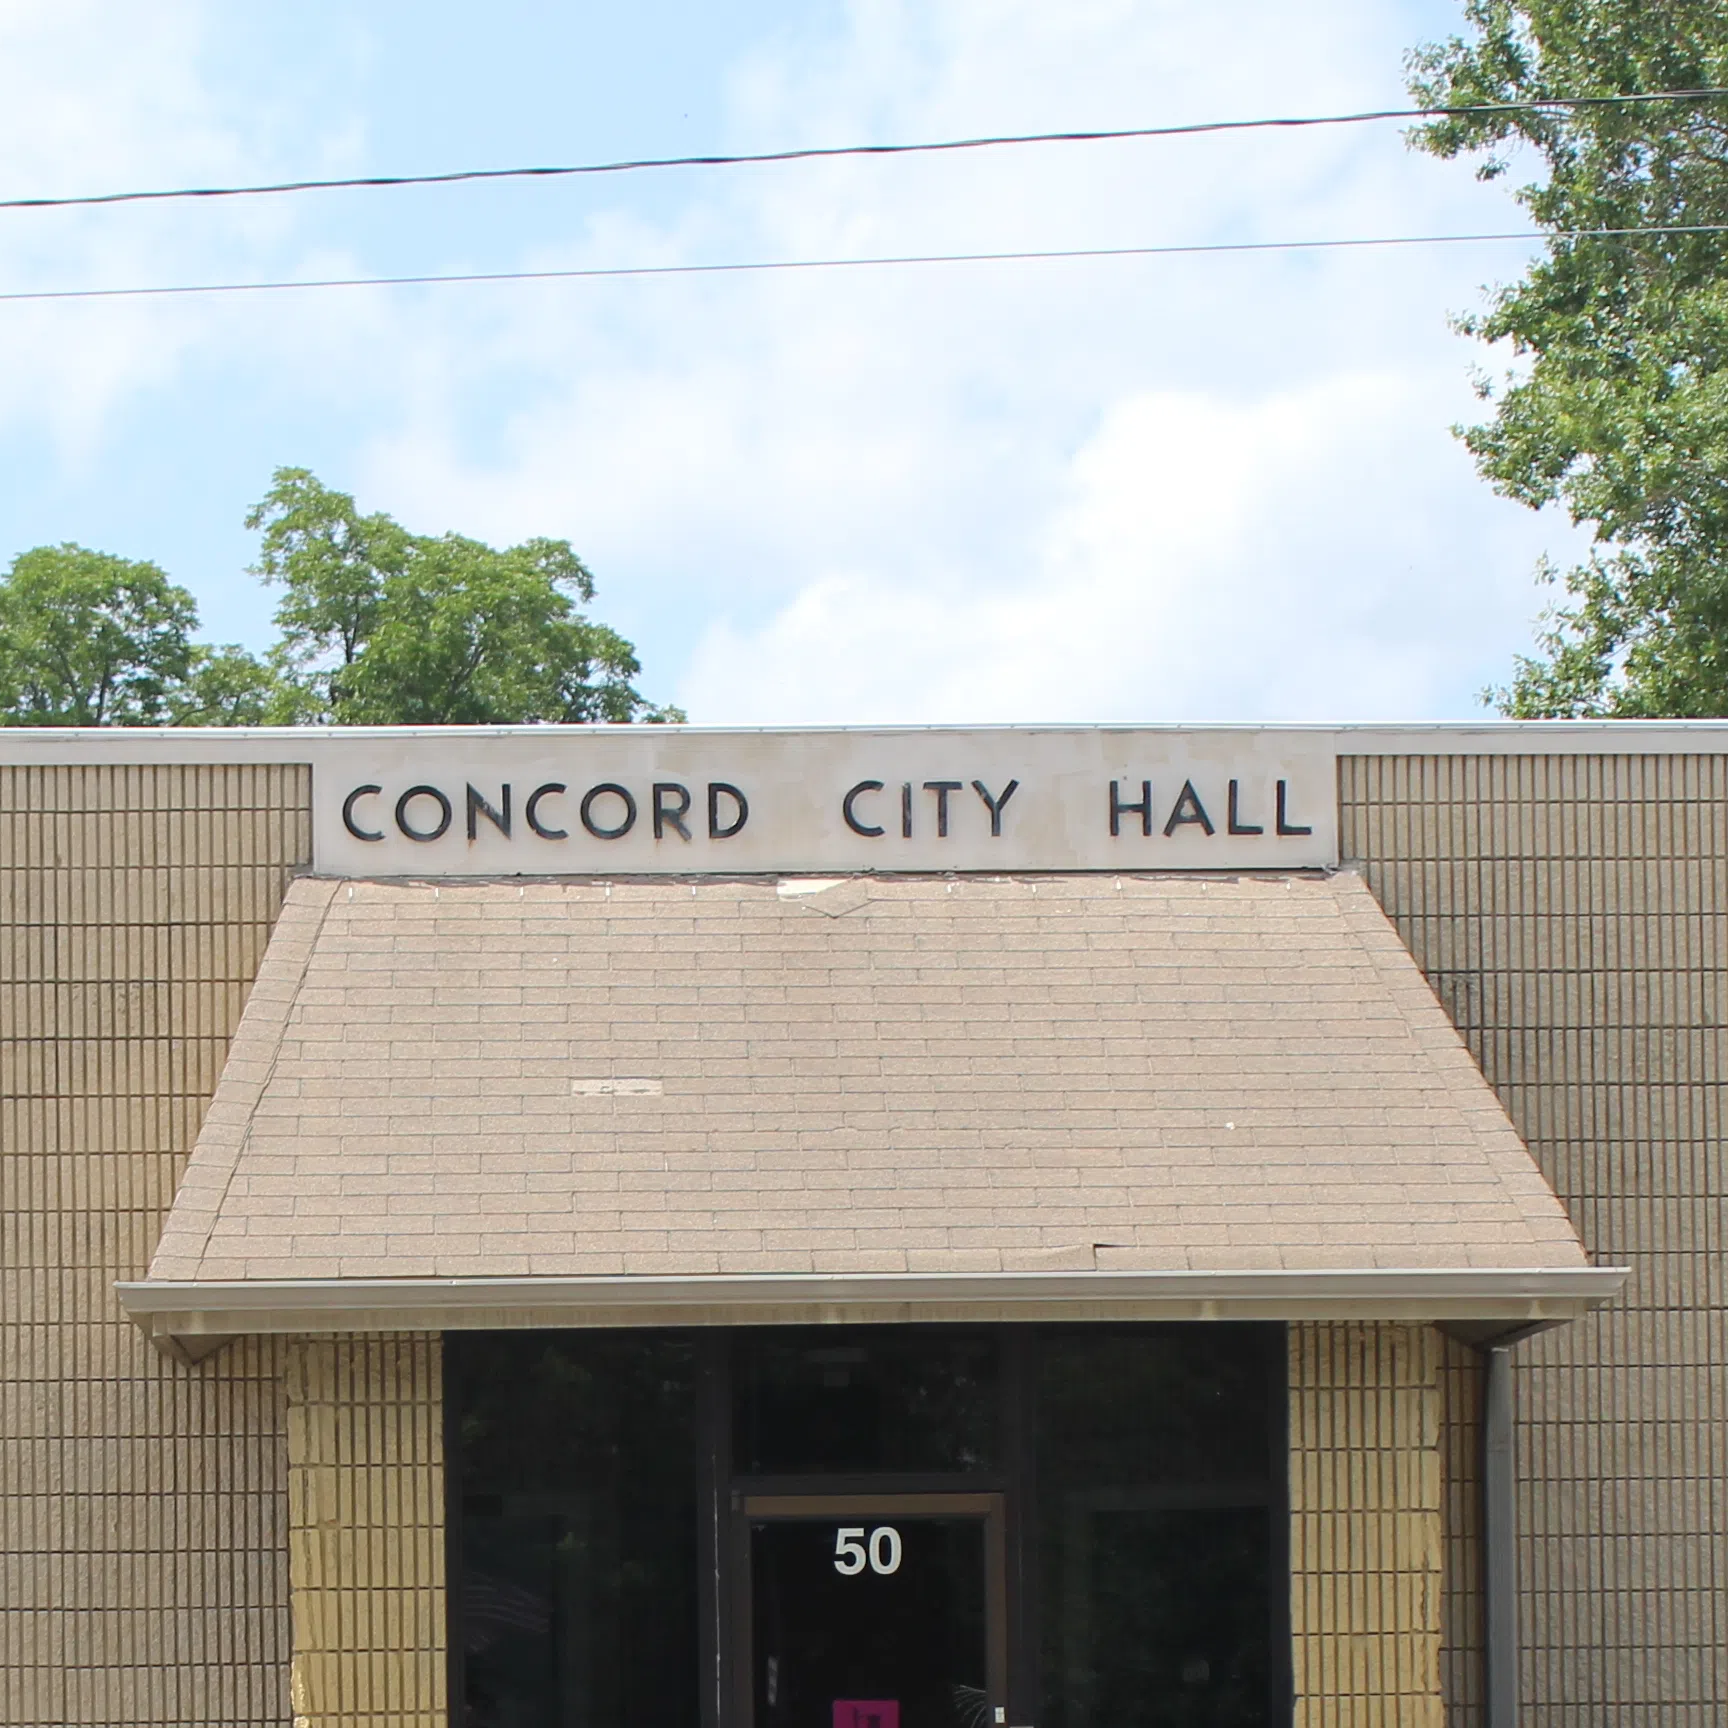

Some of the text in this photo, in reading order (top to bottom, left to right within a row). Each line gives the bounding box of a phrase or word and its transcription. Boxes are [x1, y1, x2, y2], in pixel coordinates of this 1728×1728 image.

[342, 779, 1312, 841] CONCORD CITY HALL
[833, 1526, 902, 1575] 50
